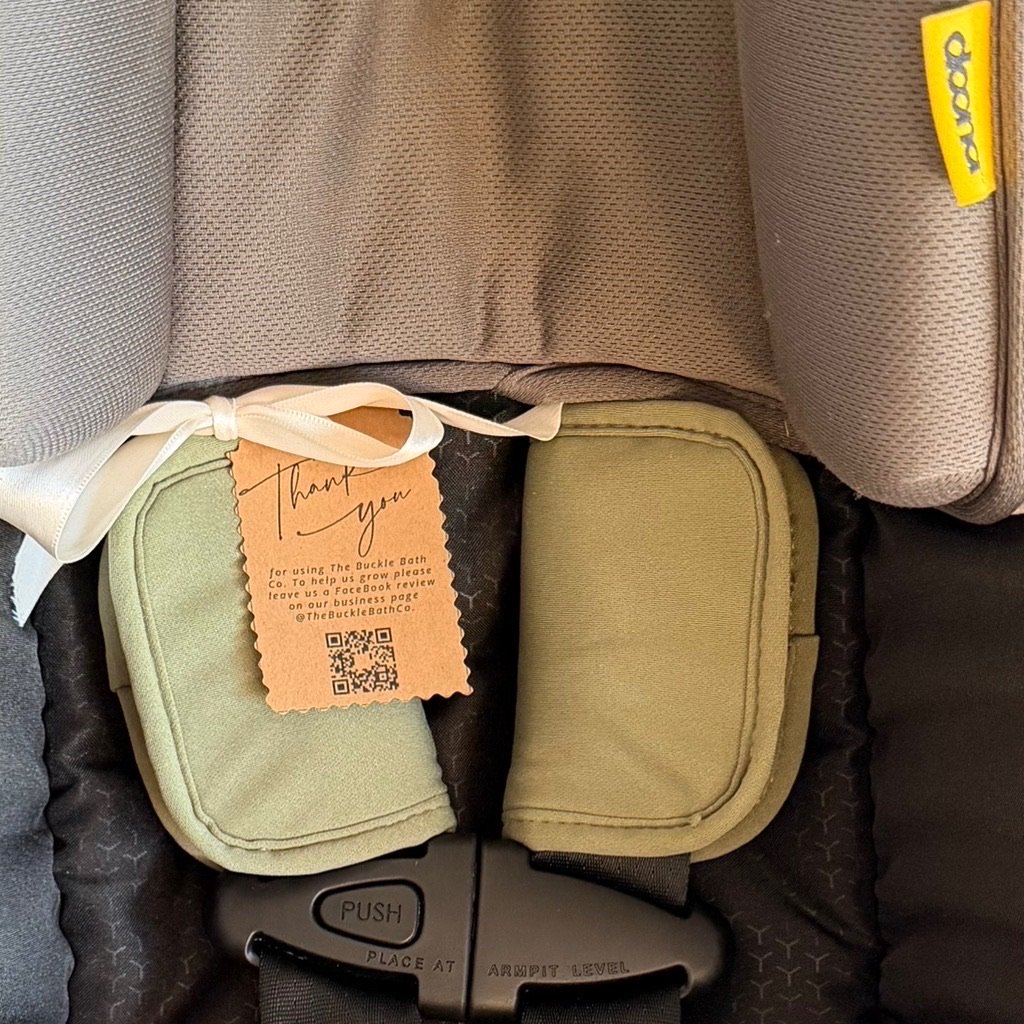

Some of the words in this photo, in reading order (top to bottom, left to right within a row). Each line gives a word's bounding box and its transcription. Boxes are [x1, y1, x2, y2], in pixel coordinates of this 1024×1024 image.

[944, 31, 981, 174] doona
[297, 489, 412, 558] you
[268, 579, 287, 588] Co.
[292, 578, 306, 587] To
[311, 576, 336, 586] help
[342, 575, 355, 583] us
[359, 572, 389, 584] grow
[394, 567, 432, 580] please
[269, 567, 288, 579] for
[292, 565, 325, 576] using
[331, 563, 351, 573] The
[356, 559, 395, 570] Buckle
[400, 555, 427, 566] Bath
[268, 591, 300, 600] leave
[305, 589, 318, 598] us
[323, 588, 330, 596] a
[335, 582, 391, 596] FaceBook
[396, 578, 436, 590] review
[288, 602, 303, 610] on
[308, 600, 328, 609] our
[333, 596, 385, 607] business
[391, 592, 419, 604] page
[295, 604, 415, 623] @TheBuckleBathCo.
[341, 900, 402, 924] PUSH
[366, 950, 425, 970] PLACE
[433, 958, 457, 974] AT
[487, 963, 560, 978] ARMPIT
[572, 961, 631, 977] LEVEL
